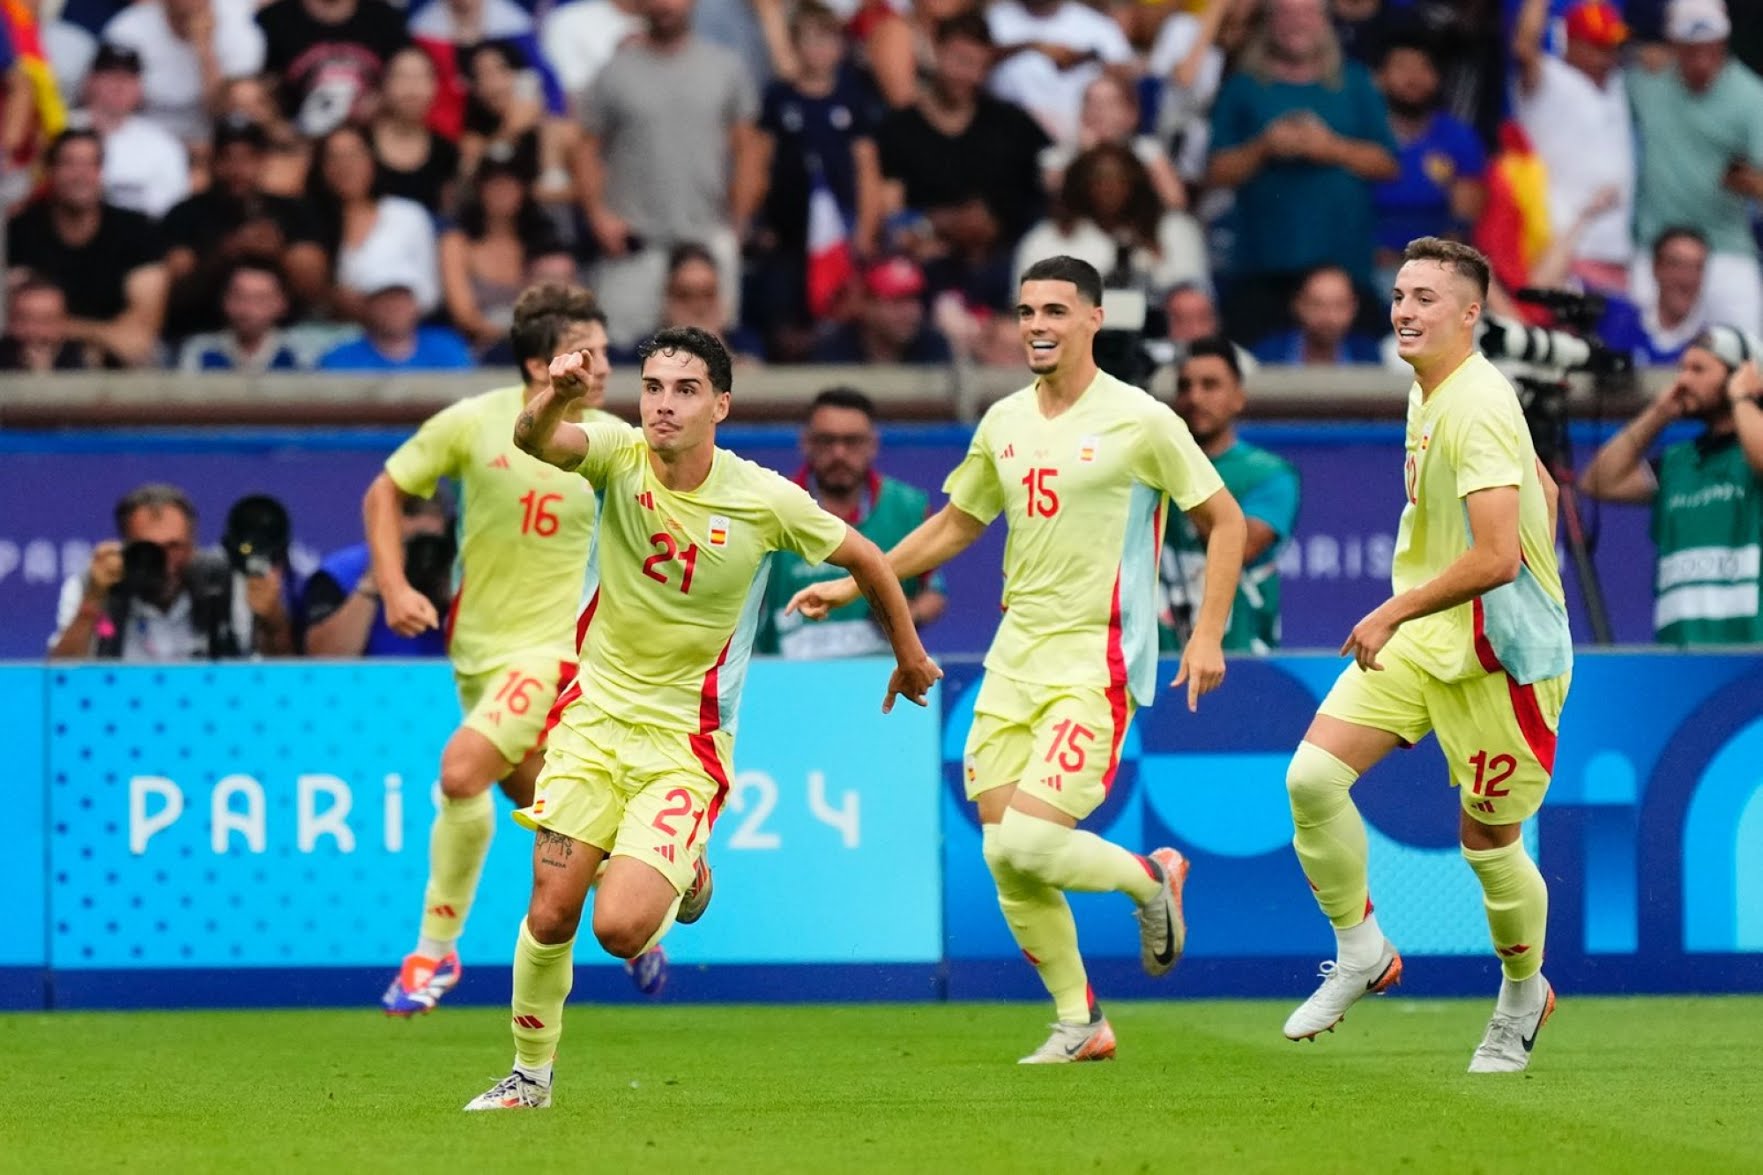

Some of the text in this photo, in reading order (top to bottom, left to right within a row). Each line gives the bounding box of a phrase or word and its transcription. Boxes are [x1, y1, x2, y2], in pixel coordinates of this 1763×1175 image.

[519, 489, 564, 537] 16
[1022, 468, 1059, 518] 15
[642, 532, 699, 595] 21
[495, 670, 545, 716] 16
[1044, 718, 1096, 773] 15
[1468, 749, 1517, 797] 12
[129, 772, 444, 855] PARi
[652, 788, 705, 850] 21
